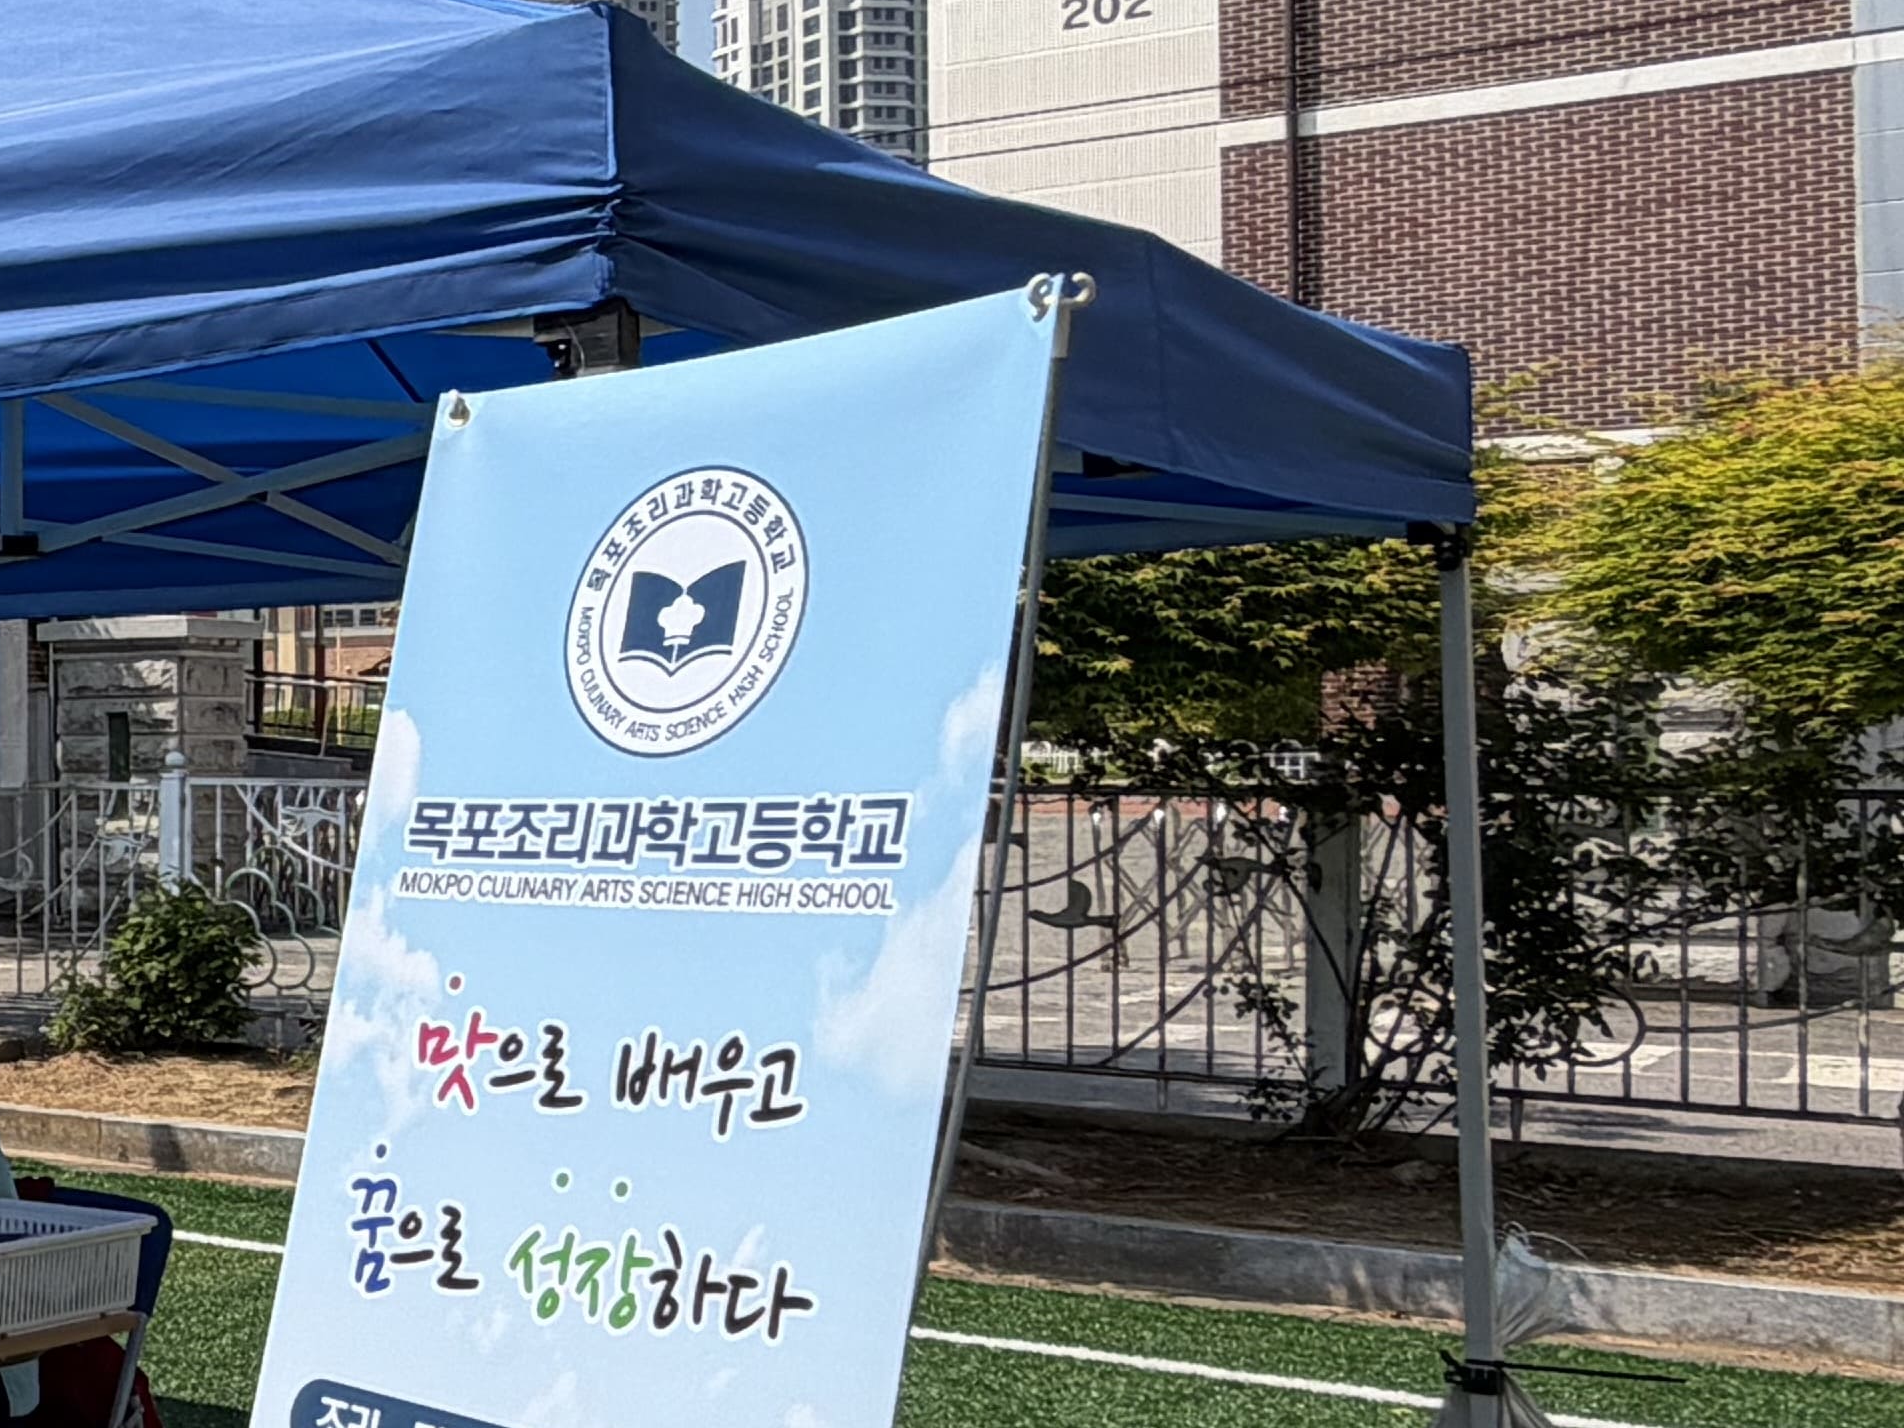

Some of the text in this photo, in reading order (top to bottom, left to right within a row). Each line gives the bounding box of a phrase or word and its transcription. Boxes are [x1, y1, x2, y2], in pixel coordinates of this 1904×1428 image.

[587, 478, 796, 591] 목포조리과학고등학교
[576, 587, 794, 742] MOKPO CULINARY ARTS SCIENCE HIGH SCHOOL
[399, 871, 894, 910] MOKPO CULINARY ARTS SCIENCE HIGH SCHOOL
[408, 798, 908, 867] 목포조리과학고등학교
[418, 1012, 804, 1135] 맛으로 배우고
[352, 1177, 814, 1340] 꿈으로 성장하다
